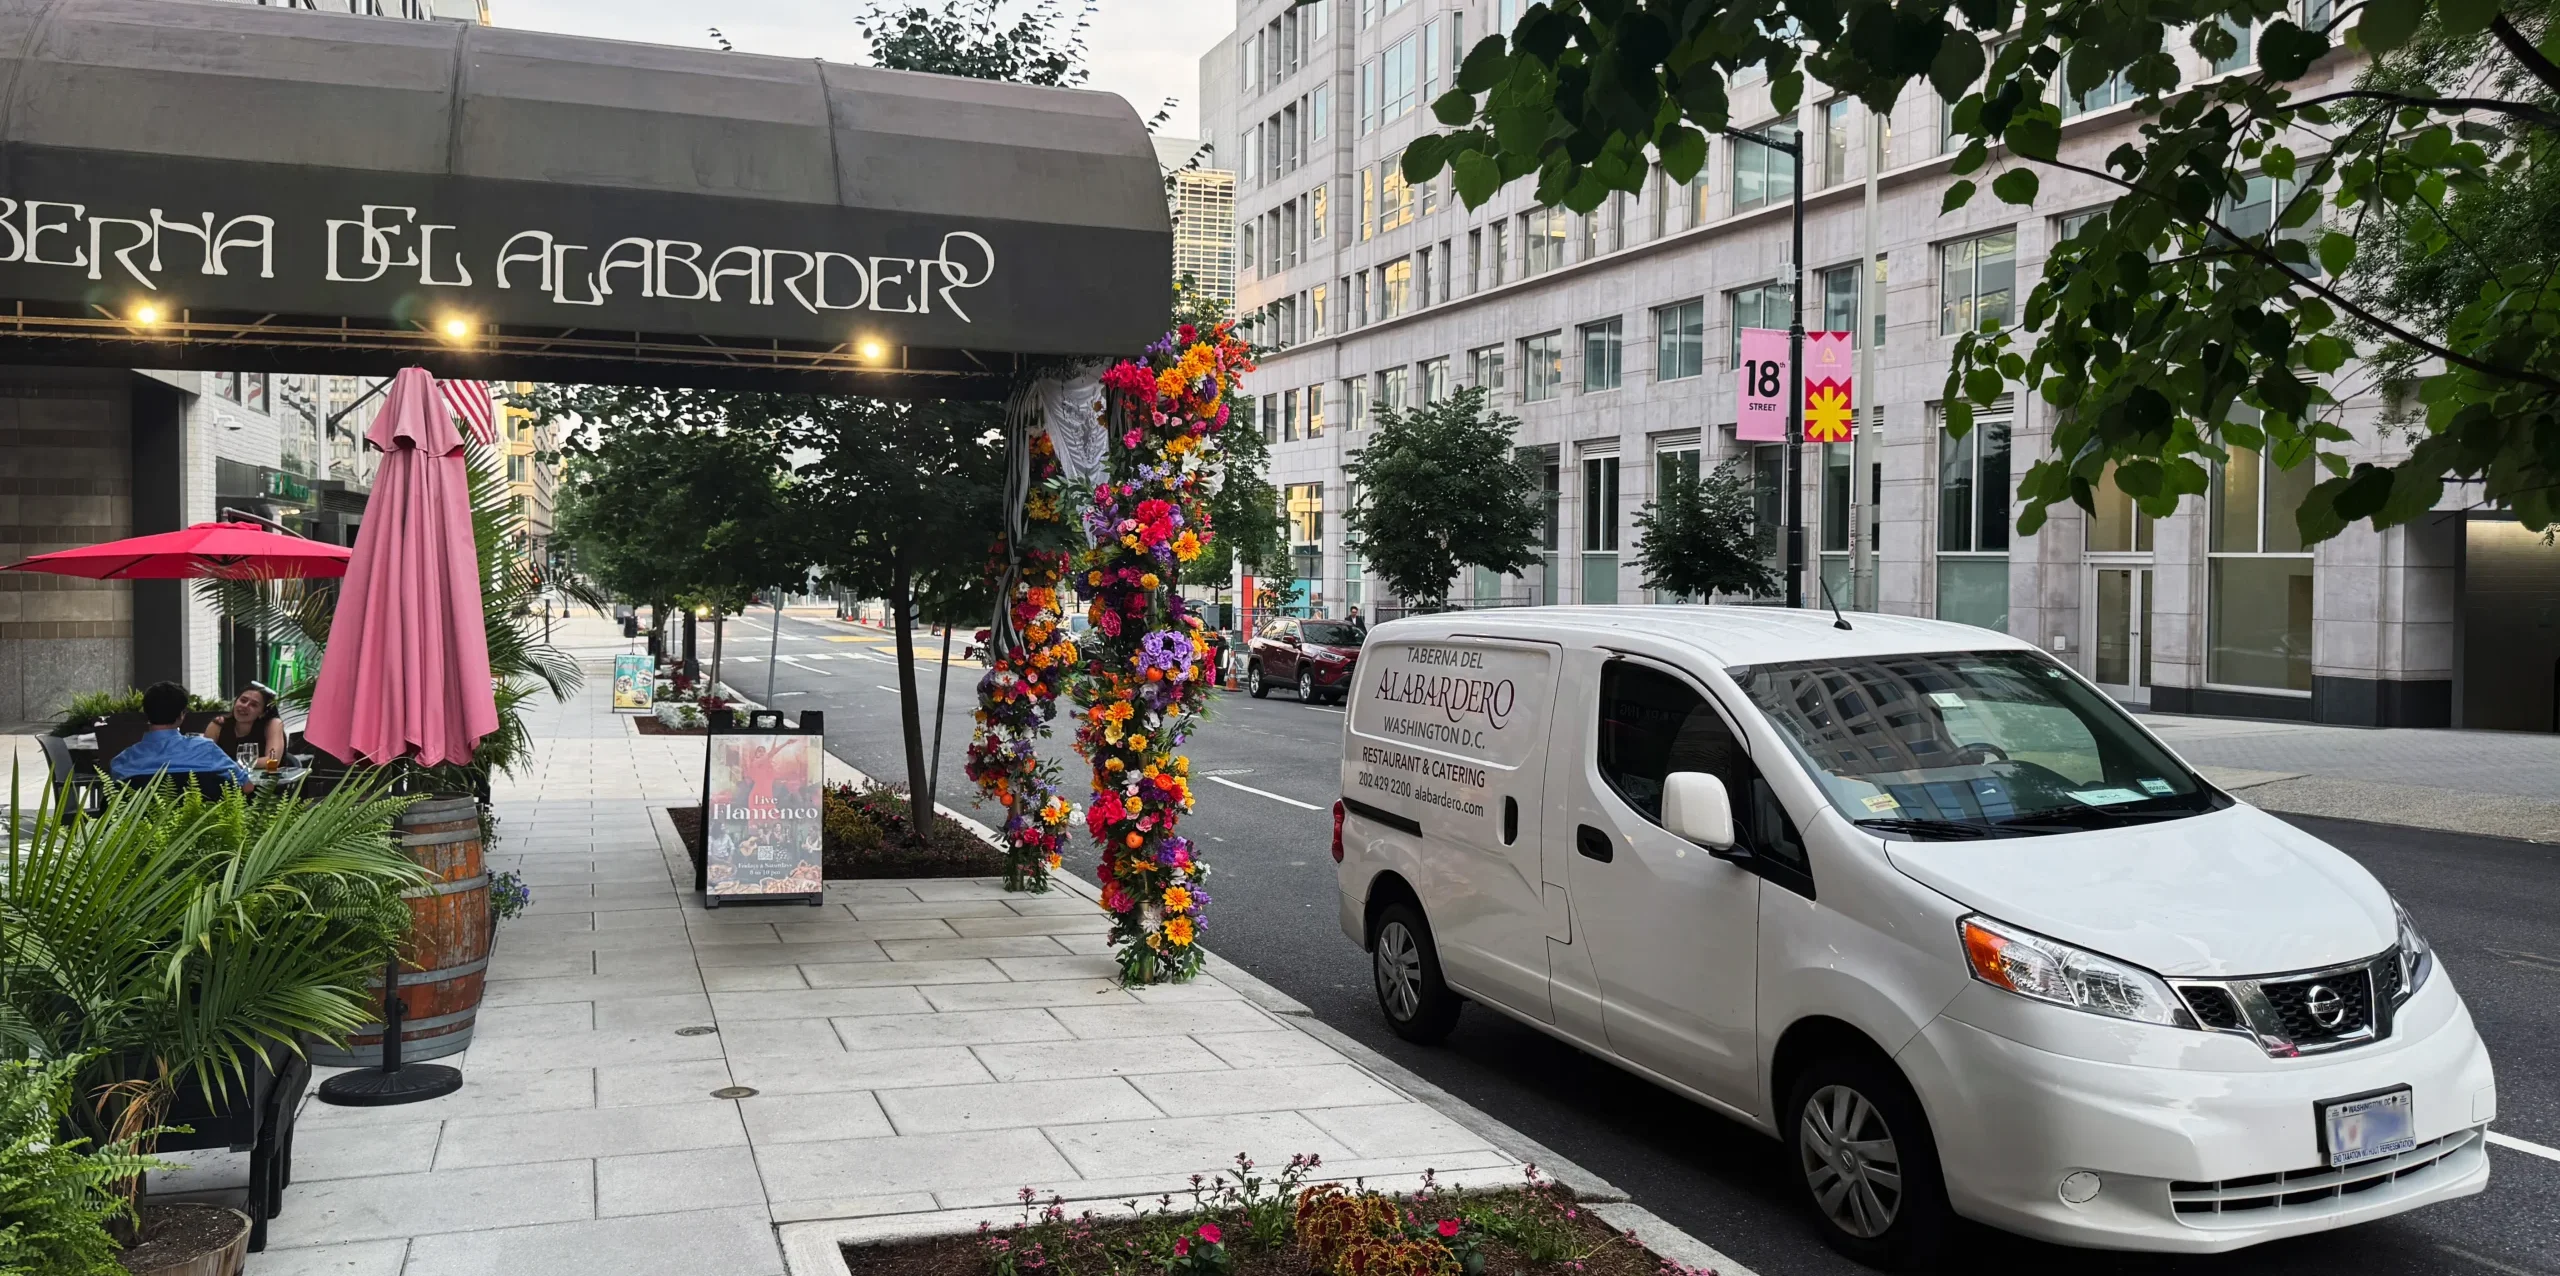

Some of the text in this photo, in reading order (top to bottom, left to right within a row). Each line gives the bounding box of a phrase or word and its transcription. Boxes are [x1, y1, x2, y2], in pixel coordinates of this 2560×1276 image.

[326, 205, 472, 287] DEL
[497, 231, 995, 323] ALABARDERO
[1749, 402, 1776, 411] STREET
[1407, 647, 1483, 669] TABERNA DEL
[1375, 667, 1515, 730] ALABARDERO
[1384, 716, 1485, 749] WASHINGTON D.C.
[1362, 746, 1485, 788] RESTAURANT & CATERING
[755, 794, 778, 805] Live
[1359, 771, 1484, 817] 202 429 2200 alabardero.com
[713, 803, 818, 820] Flamenco
[2333, 1154, 2341, 1163] END
[2380, 1139, 2415, 1153] REPRESENTATION
